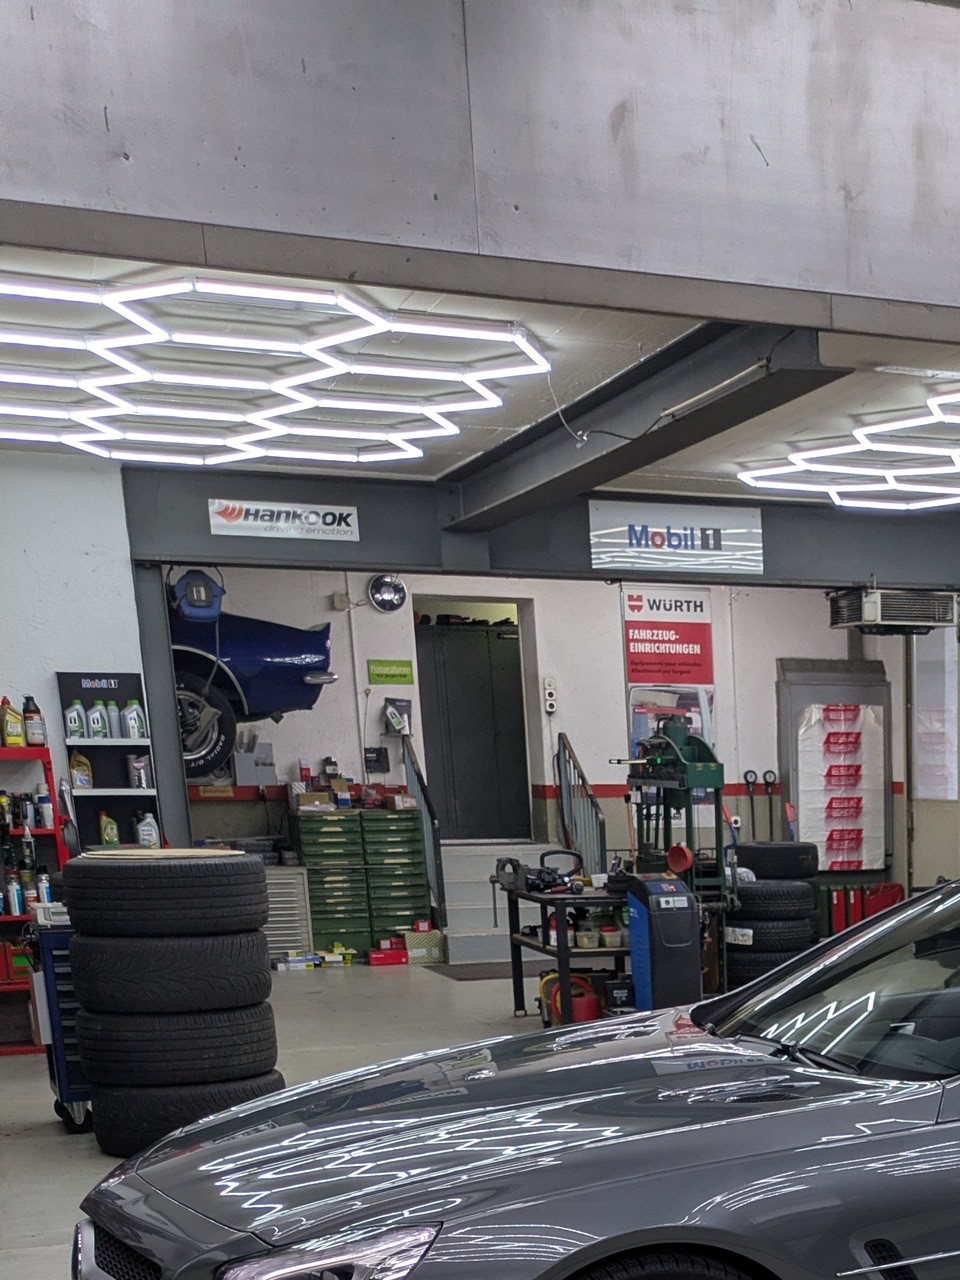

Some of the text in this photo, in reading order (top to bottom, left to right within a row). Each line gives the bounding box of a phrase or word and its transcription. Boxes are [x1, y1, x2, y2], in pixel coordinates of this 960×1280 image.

[307, 526, 354, 537] emotion
[627, 524, 695, 550] Mobil
[646, 598, 704, 613] WÜRTH
[628, 629, 680, 641] FAHRZEUG-
[629, 642, 701, 655] EINRICHTUNGEN
